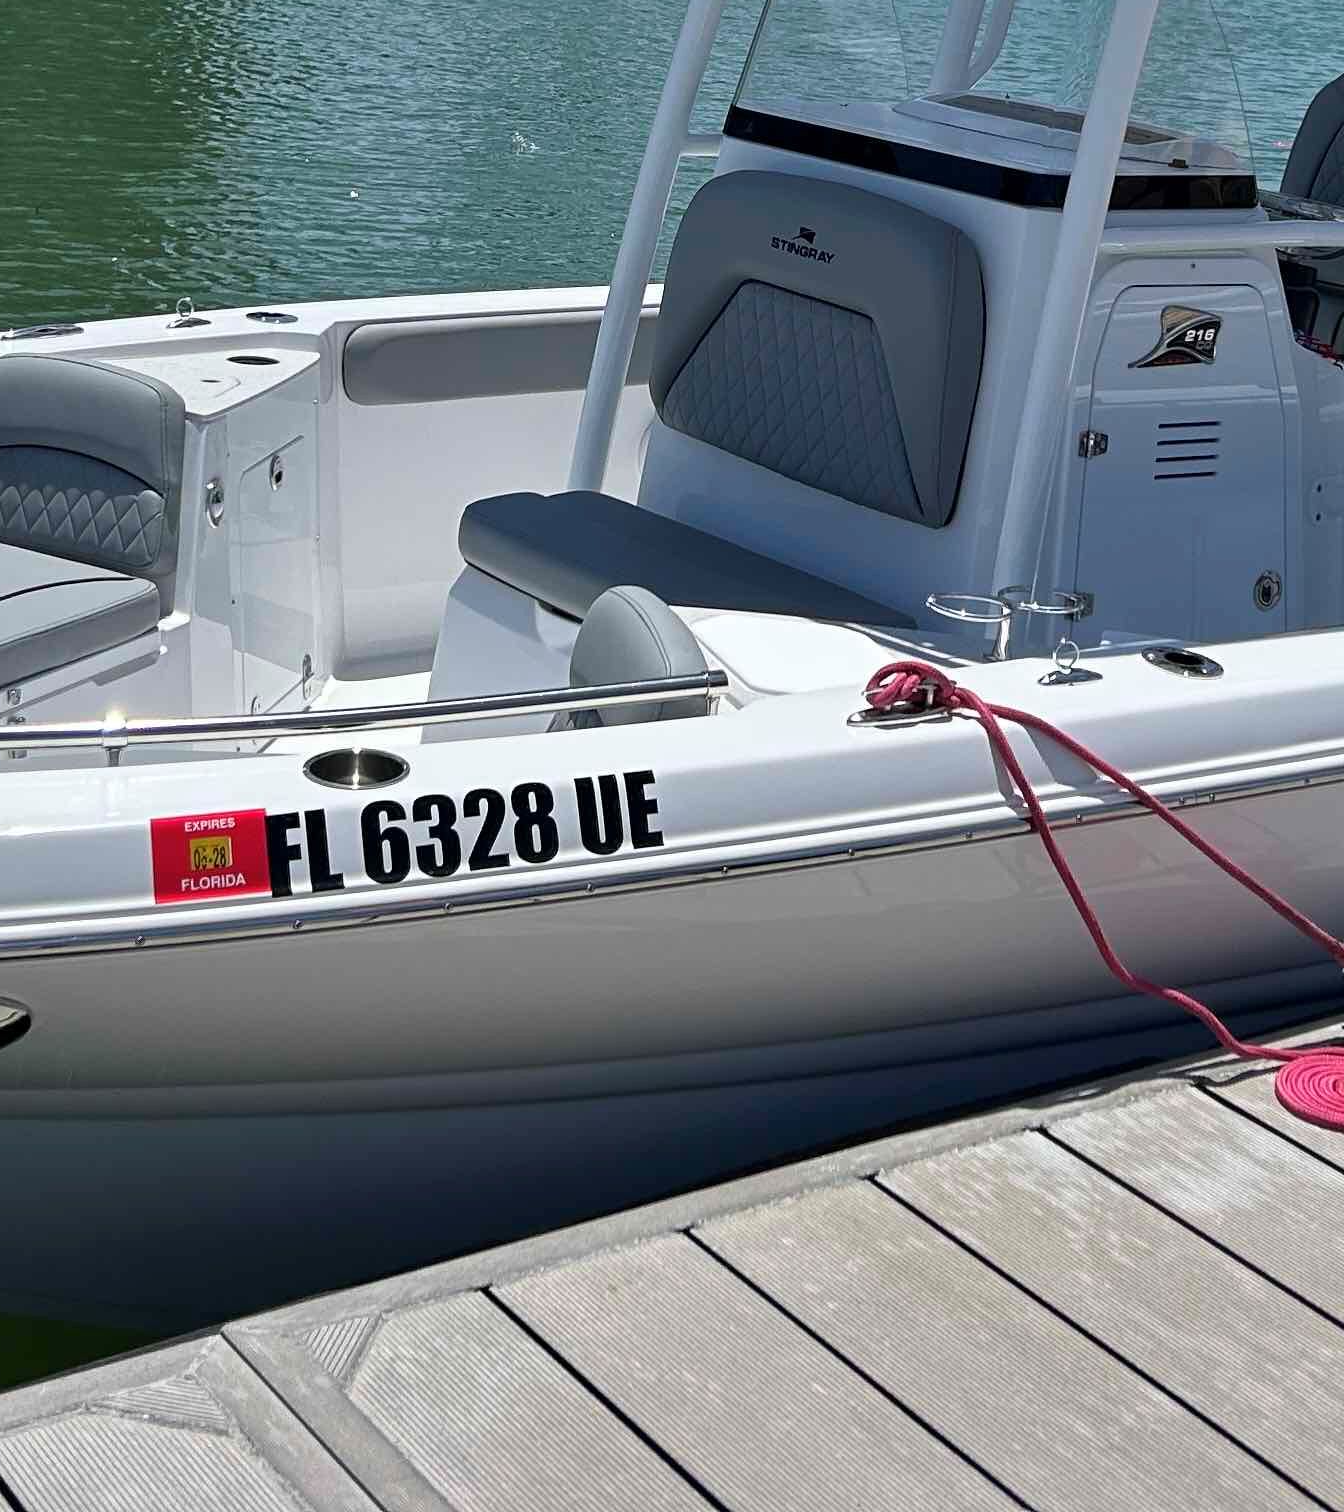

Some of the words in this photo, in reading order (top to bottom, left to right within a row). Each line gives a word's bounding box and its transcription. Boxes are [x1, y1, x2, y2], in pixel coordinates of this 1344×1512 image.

[770, 236, 836, 264] STINGRAY
[1184, 328, 1216, 342] 216
[184, 817, 236, 832] EXPIRES
[265, 808, 345, 898] FL
[360, 782, 560, 884] 6328
[573, 769, 664, 855] UE
[181, 873, 246, 891] FLORIDA
